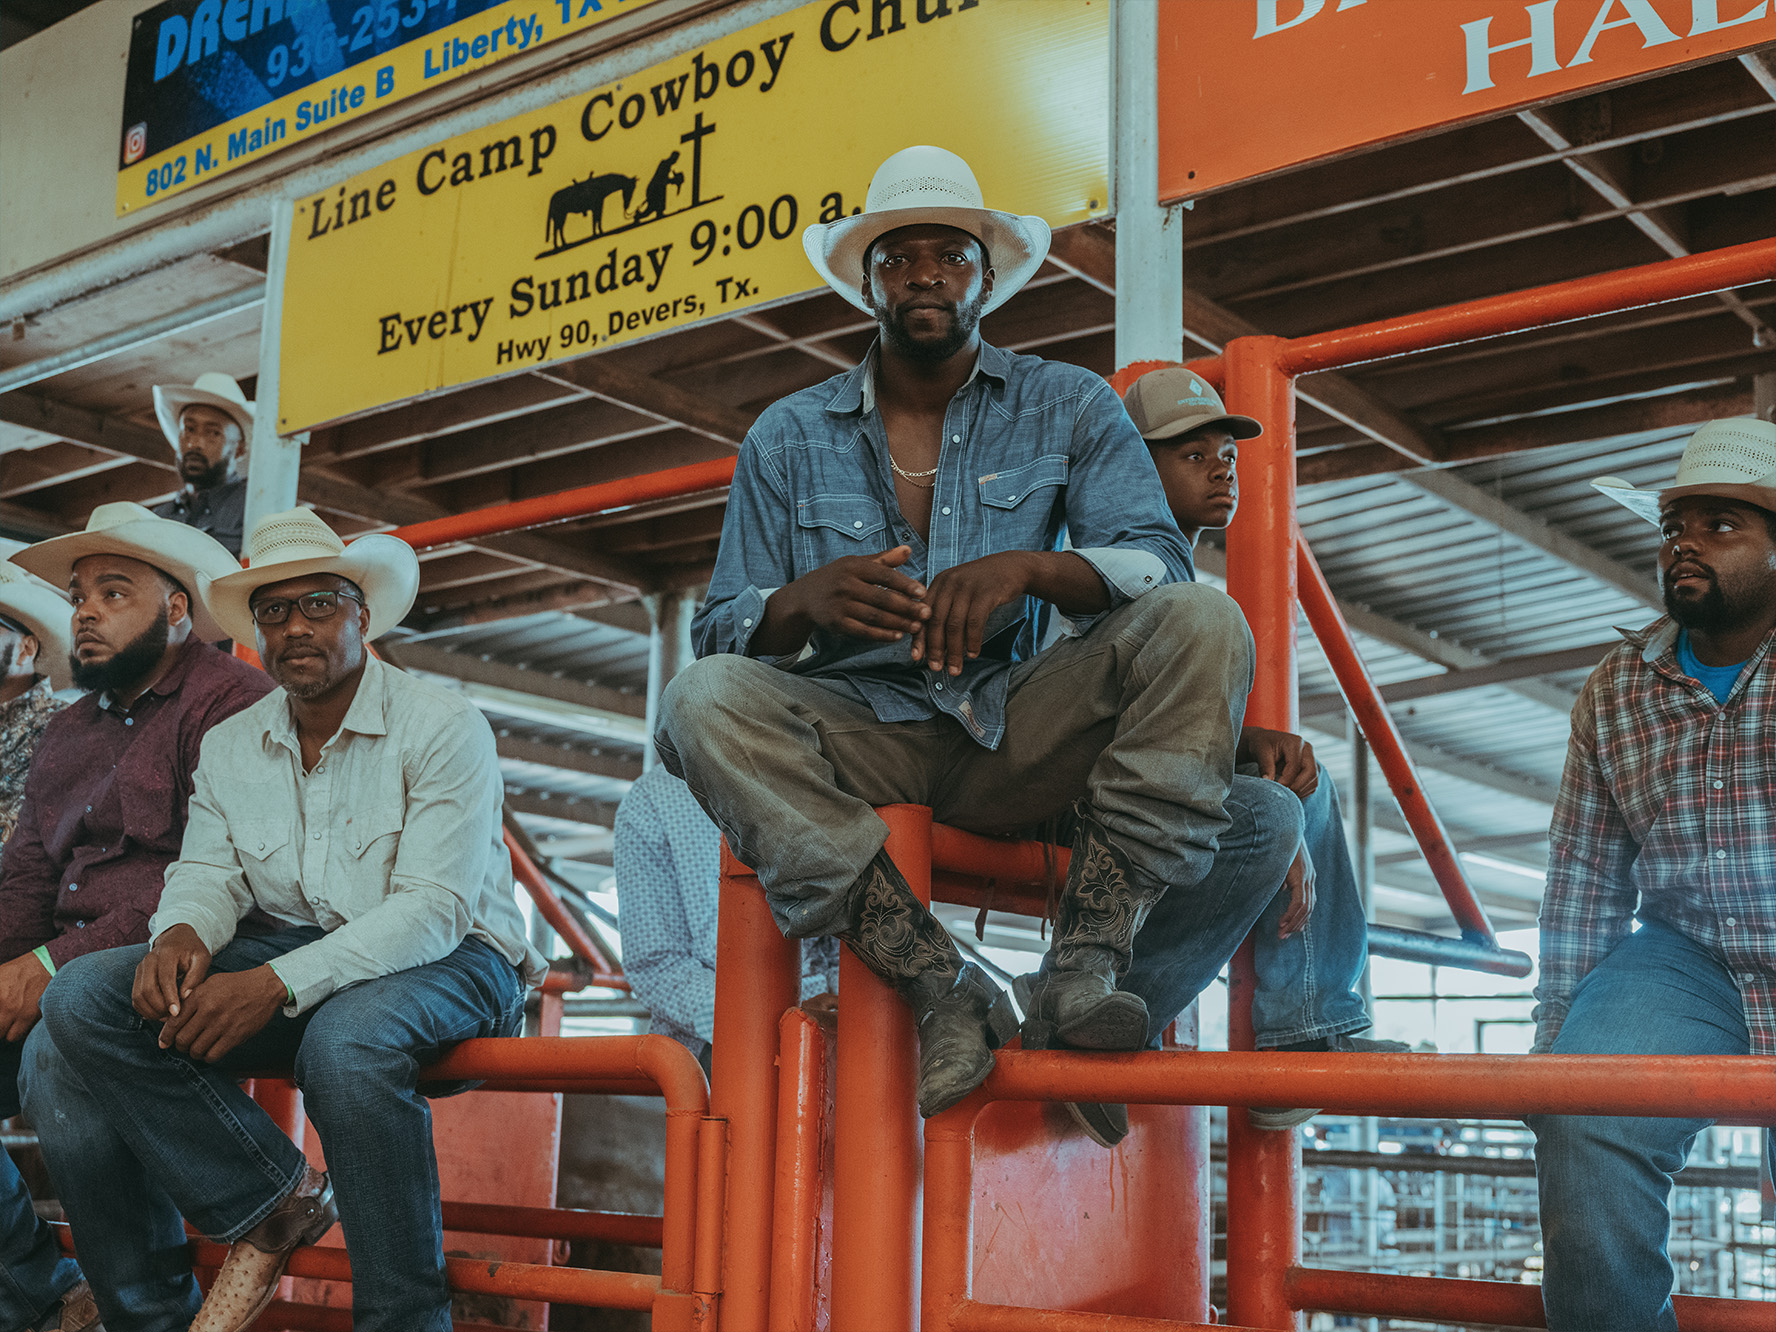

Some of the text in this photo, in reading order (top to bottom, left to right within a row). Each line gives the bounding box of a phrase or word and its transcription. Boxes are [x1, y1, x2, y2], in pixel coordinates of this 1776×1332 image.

[146, 155, 187, 197] 802
[195, 144, 218, 176] N.
[227, 117, 286, 161] Main
[295, 85, 366, 132] Suite
[376, 65, 395, 99] B
[424, 13, 543, 80] Liberty,
[267, 0, 457, 88] 936-253-
[1459, 0, 1776, 95] HAL
[308, 0, 979, 241] Line Camp Cowboy Chu
[377, 191, 862, 356] Every Sunday 9:00 a.
[496, 276, 759, 365] Hwy 90, Devers, Tx.
